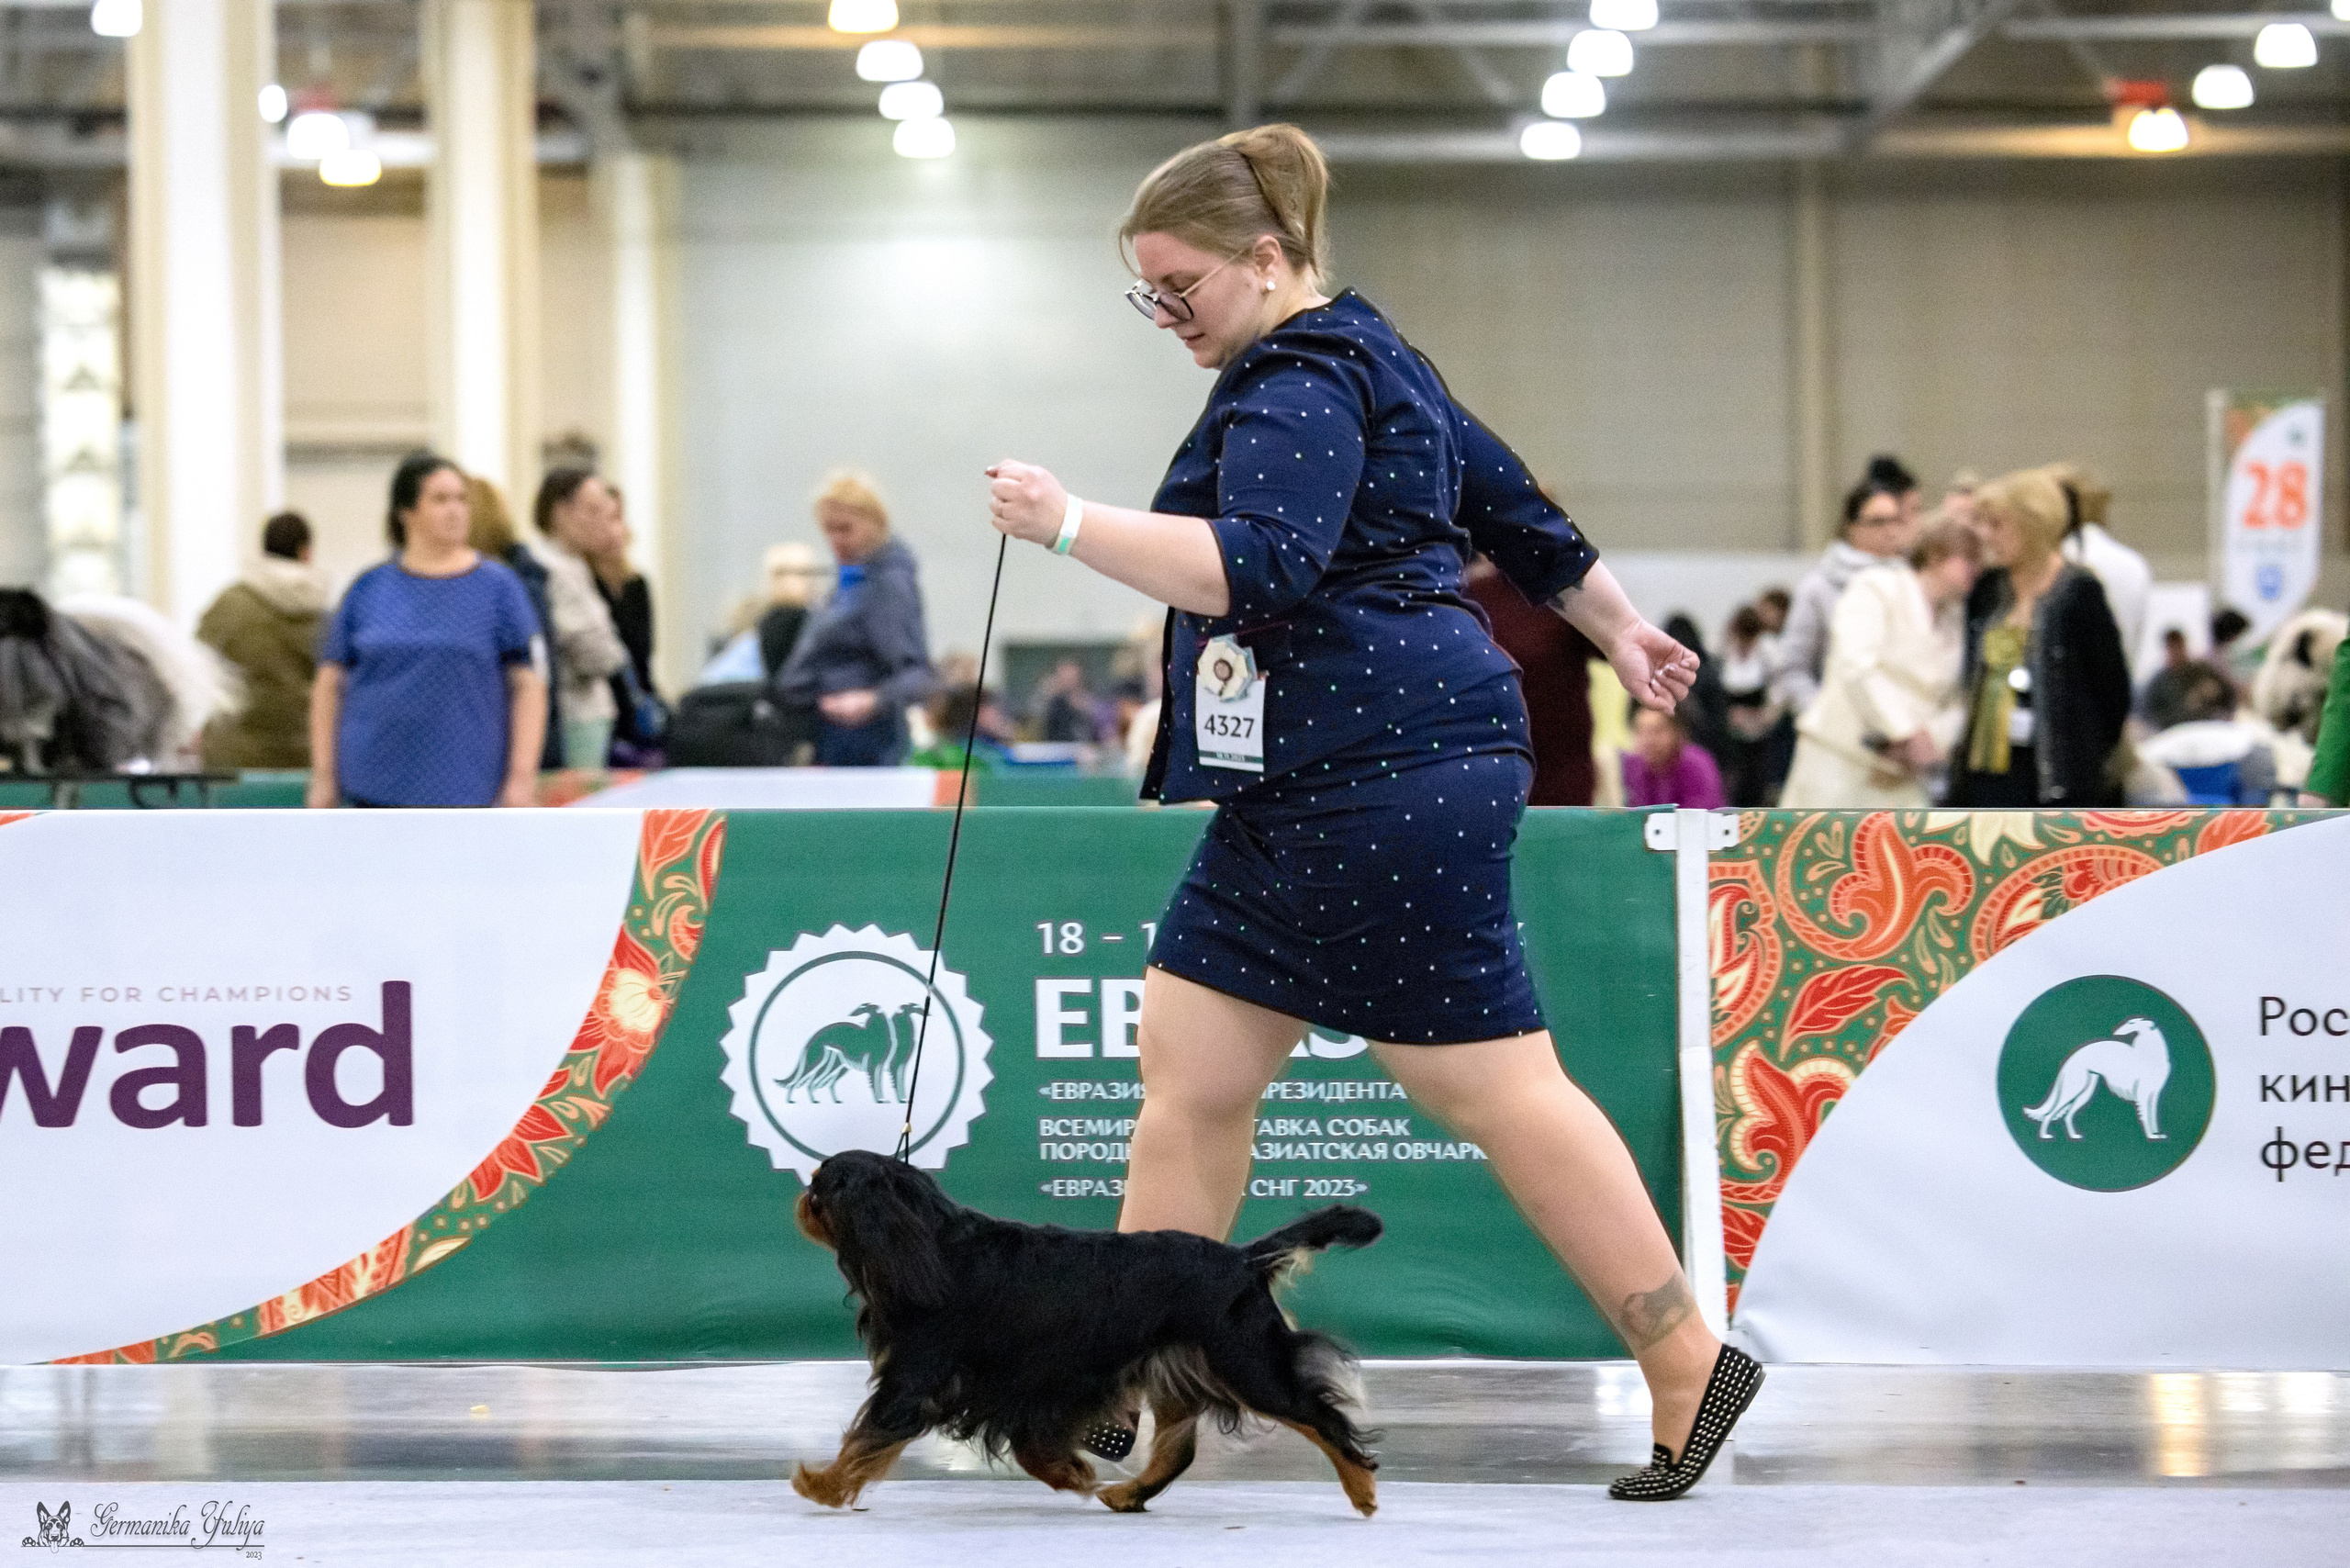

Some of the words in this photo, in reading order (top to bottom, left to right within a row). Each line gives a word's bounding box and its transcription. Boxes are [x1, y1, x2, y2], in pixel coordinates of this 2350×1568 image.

[2243, 459, 2310, 531] 28
[1203, 713, 1255, 739] 4327
[1037, 922, 1085, 955] 18
[0, 986, 64, 1003] LITY
[81, 987, 141, 1002] FOR
[158, 985, 352, 1002] CHAMPIONS
[2259, 996, 2350, 1036] Рос
[0, 980, 413, 1129] ward
[1261, 1081, 1407, 1103] РЕЗИДЕНТА
[2260, 1075, 2350, 1103] кин
[1254, 1118, 1324, 1136] АВКА
[1326, 1118, 1411, 1136] СОБАК
[1040, 1142, 1131, 1163] ПОРОД
[1040, 1179, 1128, 1196] «ЕВРАЗ
[1249, 1179, 1300, 1196] СНГ
[1303, 1179, 1368, 1196] 2023»
